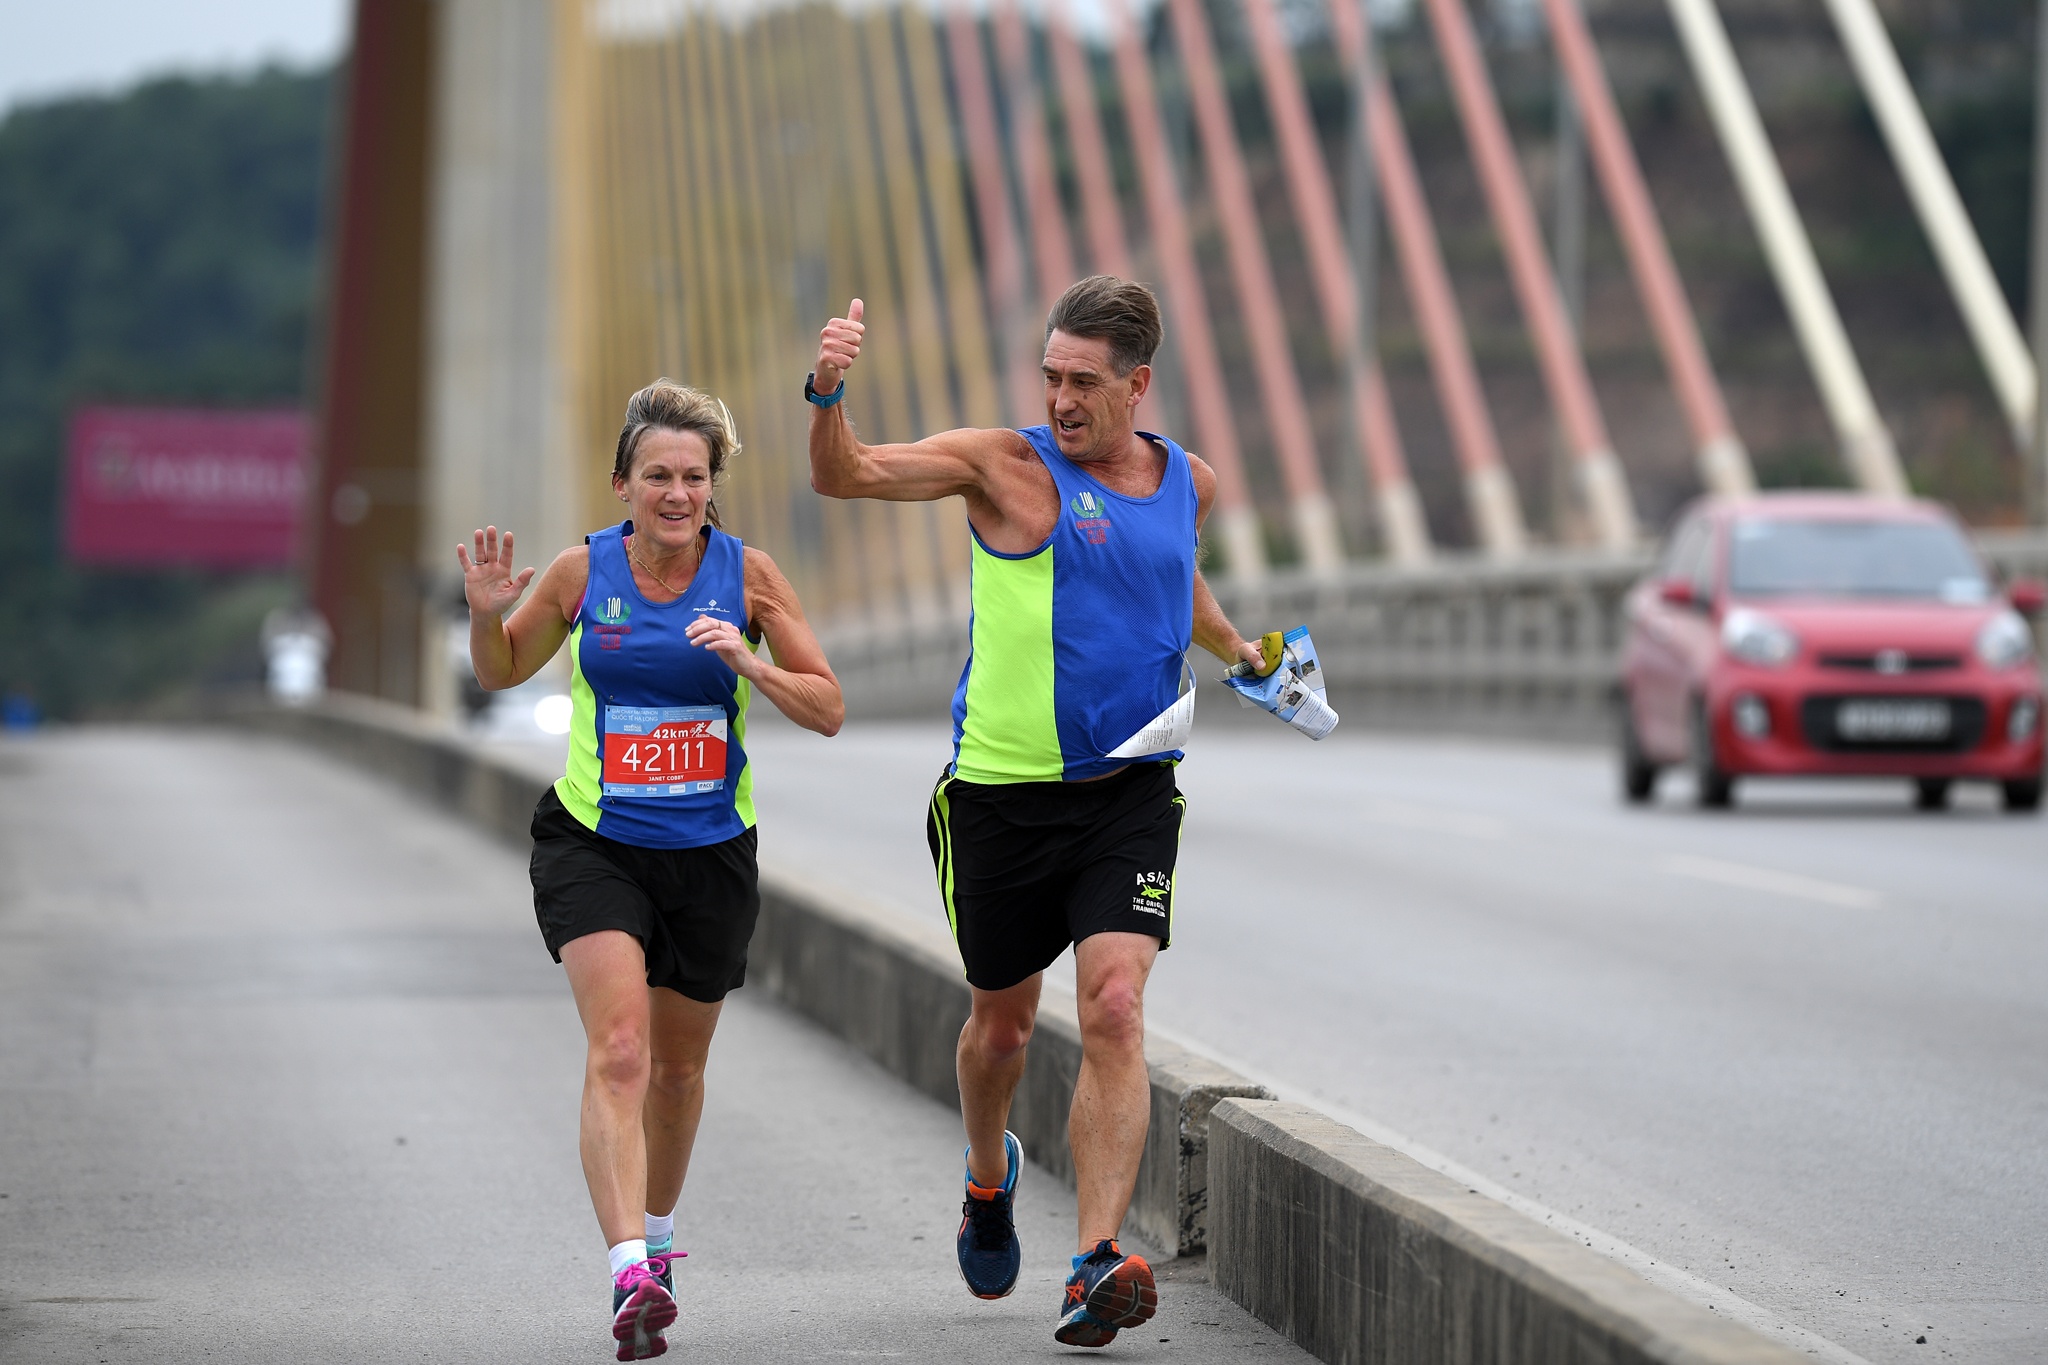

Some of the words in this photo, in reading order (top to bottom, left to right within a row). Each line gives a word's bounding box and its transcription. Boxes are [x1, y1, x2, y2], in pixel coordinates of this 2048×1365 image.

[1079, 492, 1095, 511] 100
[606, 597, 621, 618] 100
[600, 635, 621, 650] CLUB
[653, 729, 688, 739] 42km
[622, 741, 704, 772] 42111
[1137, 871, 1170, 891] ASICS
